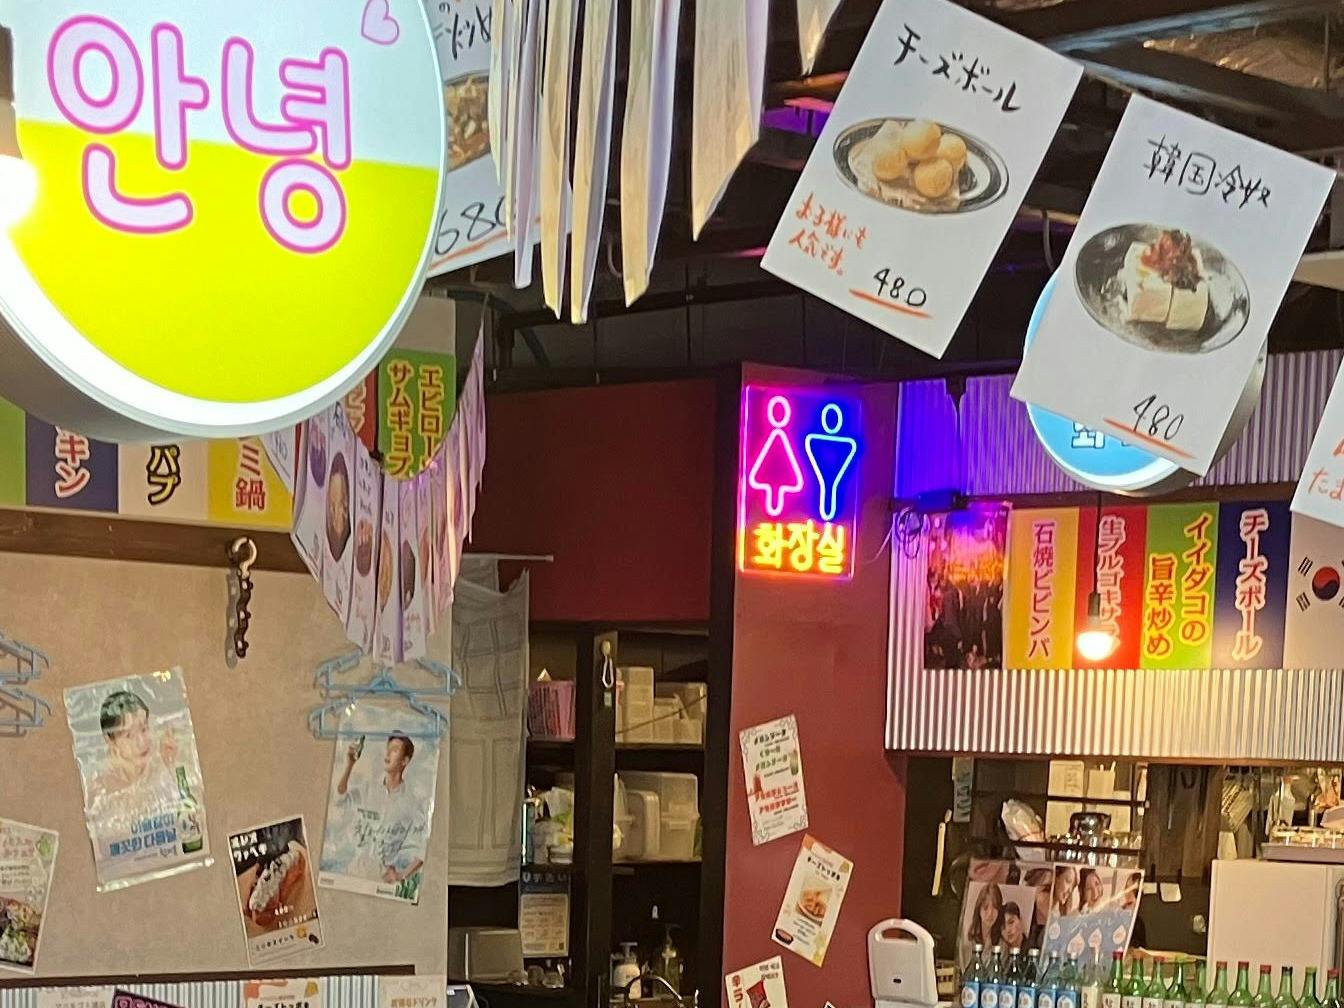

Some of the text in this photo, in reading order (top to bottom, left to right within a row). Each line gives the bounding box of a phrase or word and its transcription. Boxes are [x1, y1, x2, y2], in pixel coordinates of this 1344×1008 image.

[894, 23, 1020, 114] チーズボール
[47, 13, 354, 254] 안녕
[1144, 134, 1272, 209] 韓国冷奴
[873, 268, 928, 307] 480
[1133, 393, 1185, 441] 480
[752, 519, 846, 575] 화장실
[1180, 512, 1213, 647] イイダコの
[1232, 509, 1269, 661] チーズボール
[1145, 553, 1176, 658] 旨辛炒め
